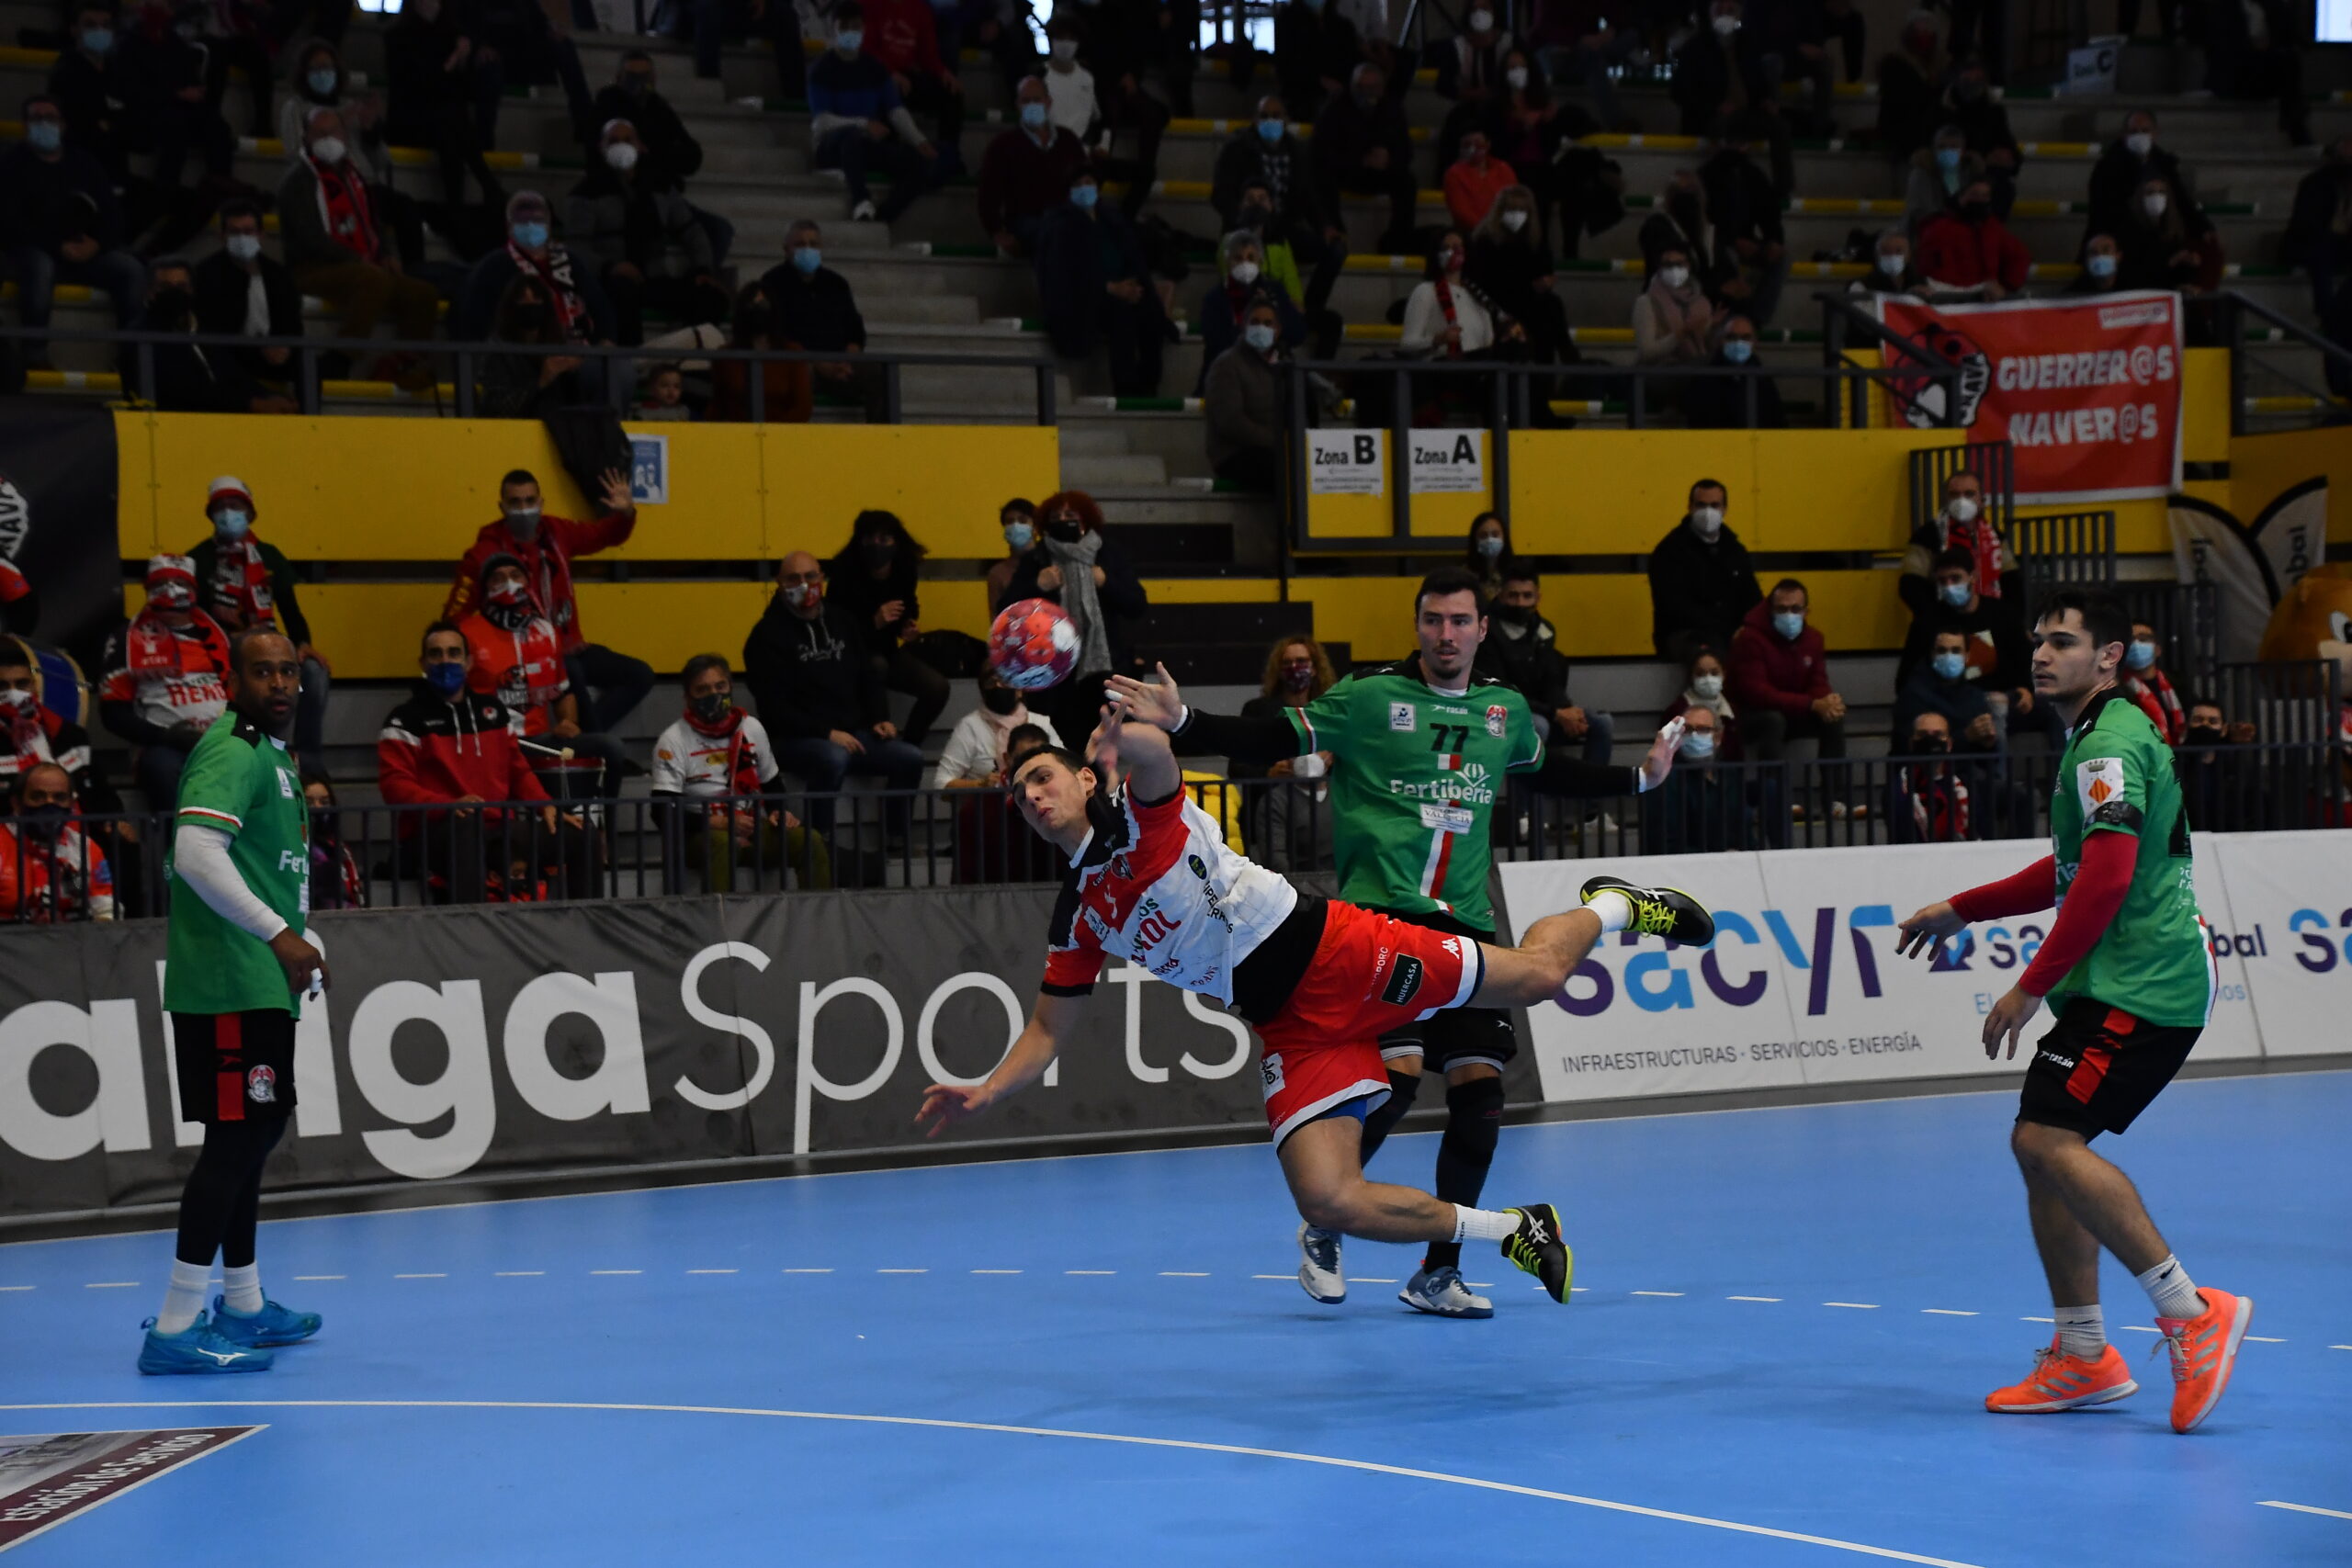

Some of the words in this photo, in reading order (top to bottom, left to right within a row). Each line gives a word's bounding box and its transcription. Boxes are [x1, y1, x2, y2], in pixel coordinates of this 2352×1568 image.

[1996, 344, 2175, 391] GUERRER@S
[2008, 402, 2158, 447] NAVER@S
[1315, 447, 1349, 465] Zona
[1354, 434, 1376, 465] B
[1415, 447, 1448, 465] Zona
[1452, 434, 1476, 465] A
[1429, 723, 1469, 752] 77
[1390, 779, 1493, 805] Fertiberia
[1396, 963, 1419, 1003] HUERCASA
[1562, 1044, 1737, 1074] INFRAESTRUCTURAS
[1750, 1039, 1838, 1062] SERVICIOS
[1849, 1031, 1922, 1055] ENERGÍA
